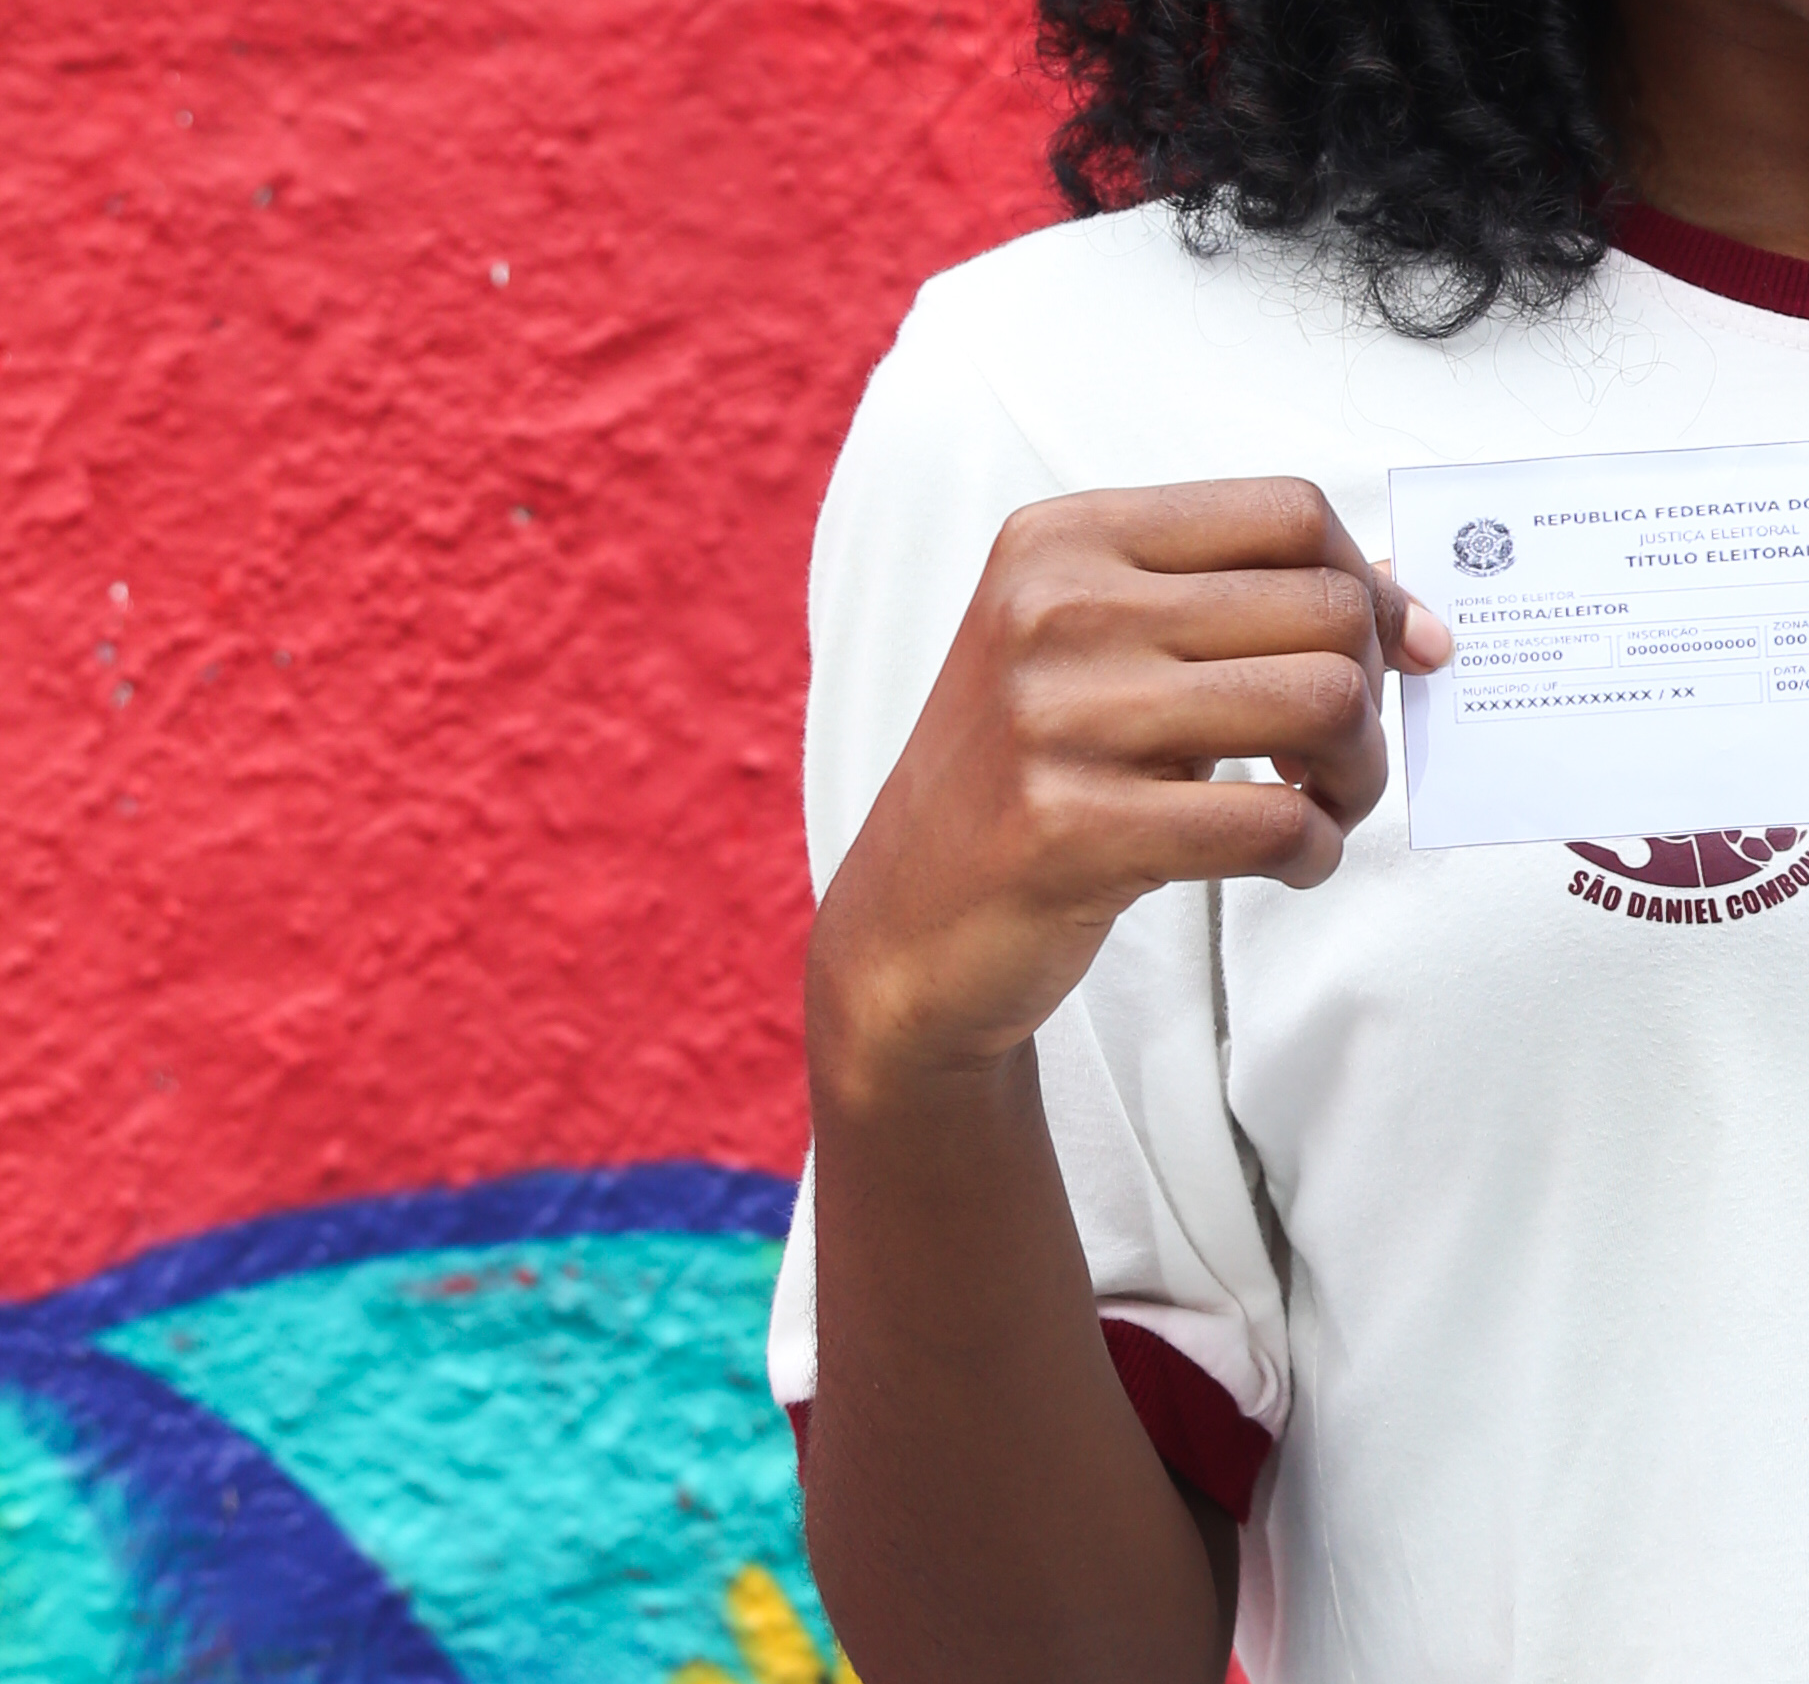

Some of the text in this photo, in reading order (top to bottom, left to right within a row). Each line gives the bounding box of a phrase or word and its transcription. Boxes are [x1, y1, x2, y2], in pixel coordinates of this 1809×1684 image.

[1533, 508, 1647, 527] REPÚBLICA
[1655, 501, 1780, 518] FEDERATIVA
[1639, 524, 1801, 547] JUSTIÇA ELEITORAL
[1624, 550, 1698, 568] TÍTULO
[1455, 591, 1575, 607] NOME DO ELEITOR
[1458, 603, 1630, 624] ELEITORA/ELEITOR
[1773, 620, 1809, 630] ZONA
[1456, 633, 1600, 651] DATA DE NASCIMENTO
[1773, 664, 1806, 676] DATA
[1542, 681, 1558, 692] UF
[1567, 870, 1622, 912] SÃO
[1626, 892, 1723, 924] DANIEL
